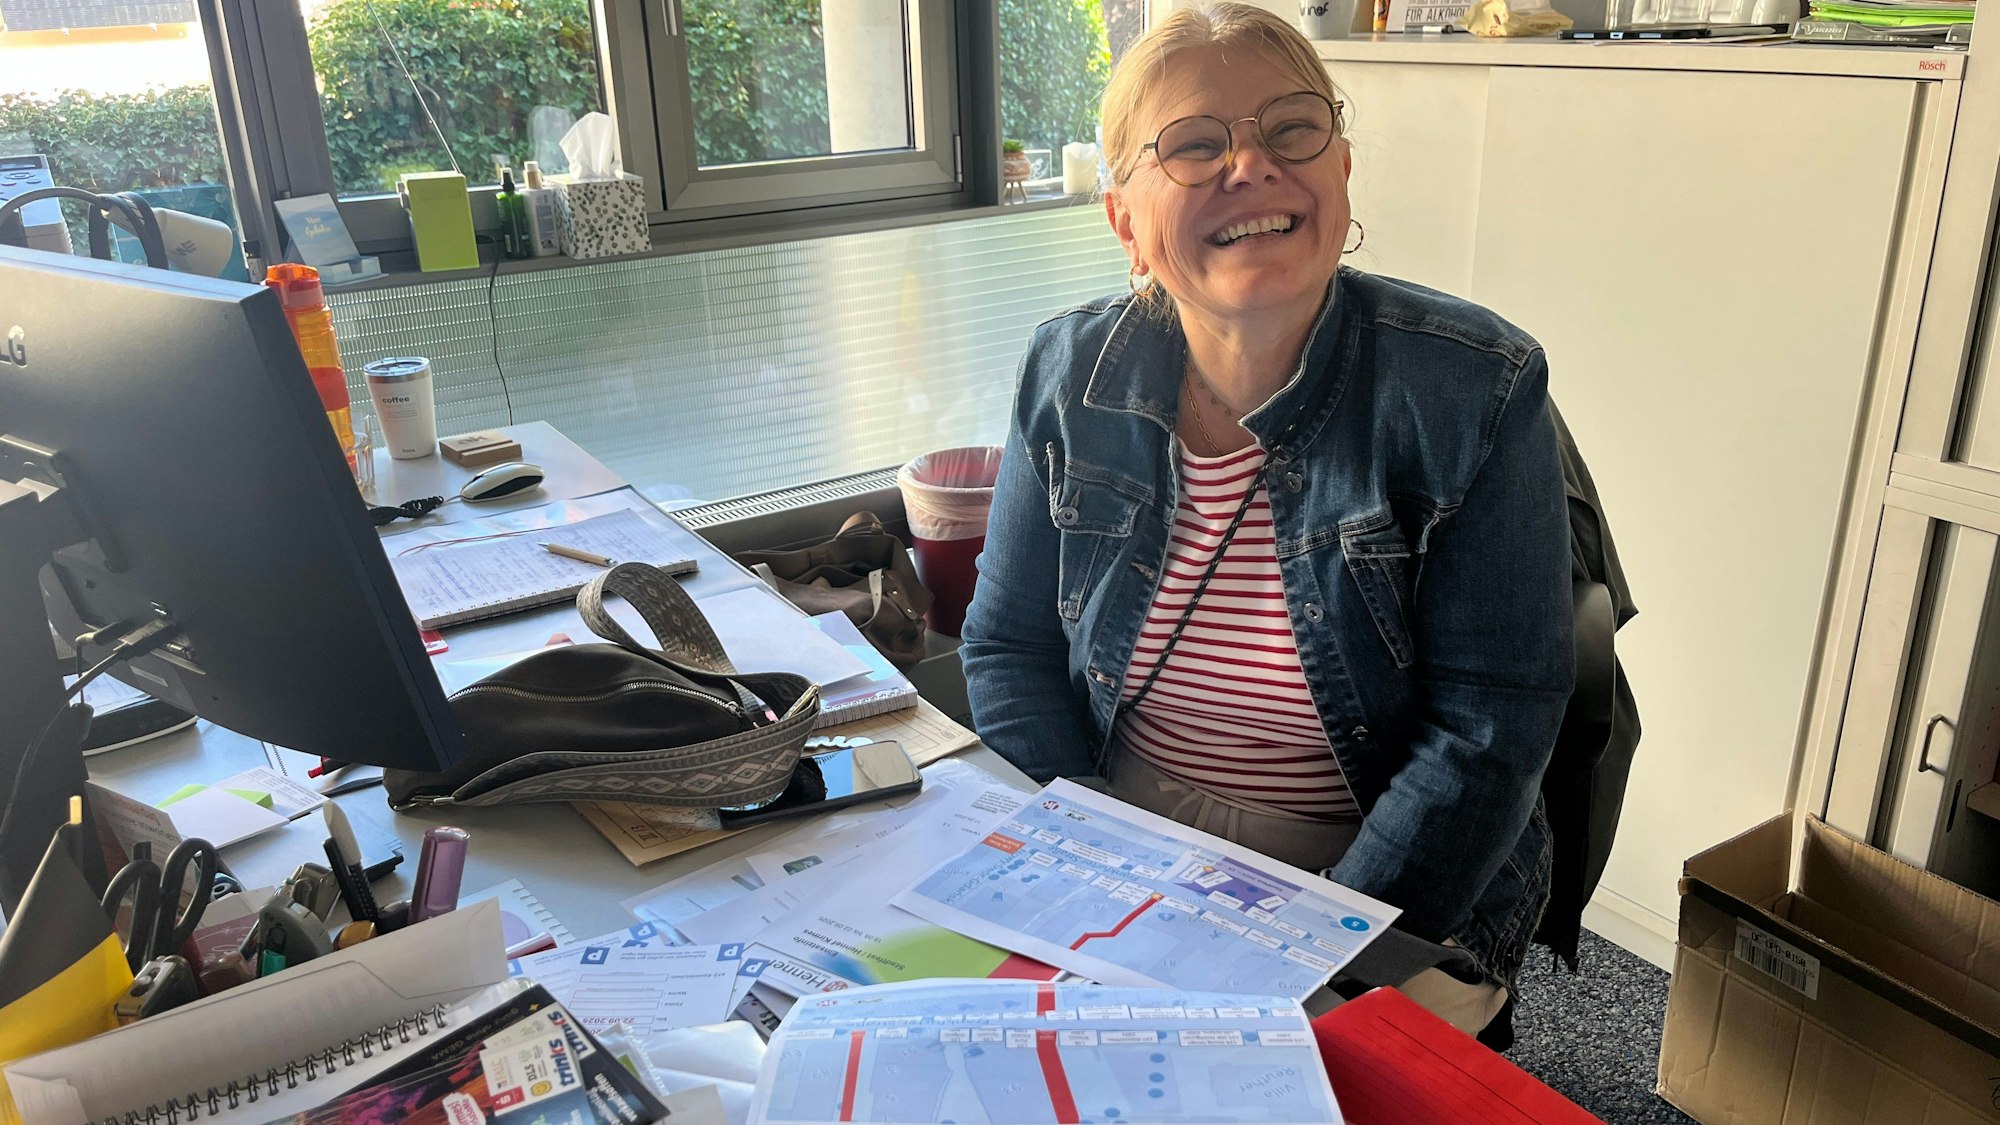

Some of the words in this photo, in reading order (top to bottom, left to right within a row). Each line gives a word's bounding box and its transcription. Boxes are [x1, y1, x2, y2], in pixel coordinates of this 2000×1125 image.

[1919, 60, 1946, 71] Rösch
[383, 396, 410, 404] coffee
[803, 928, 830, 944] Kirmes
[794, 936, 838, 958] Einsatzinfo
[831, 940, 862, 955] Hennef
[867, 950, 906, 970] Stadtfest
[548, 1010, 588, 1054] trinks
[549, 1038, 576, 1086] trinks
[1240, 1065, 1296, 1092] Reuther
[1264, 1084, 1296, 1099] Villa
